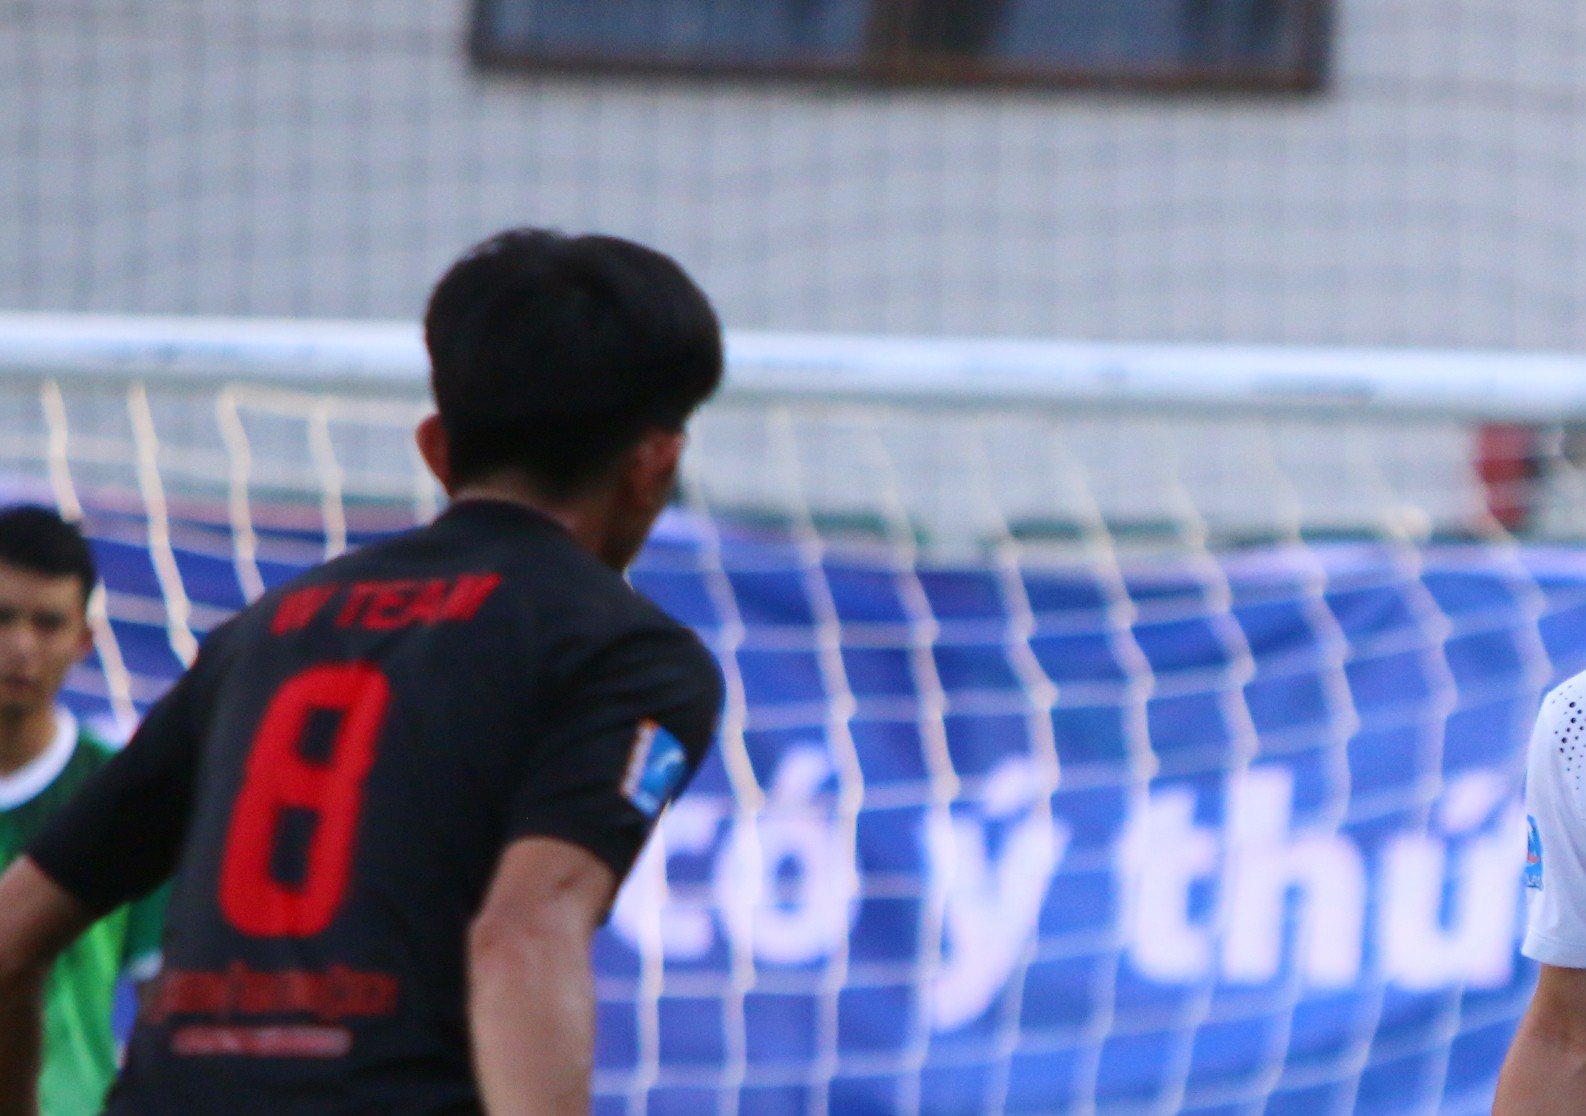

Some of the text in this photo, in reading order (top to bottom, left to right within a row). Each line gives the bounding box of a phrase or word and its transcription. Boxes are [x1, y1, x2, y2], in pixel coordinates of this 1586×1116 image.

[334, 572, 502, 631] TEAM
[219, 659, 390, 937] 8
[607, 742, 1528, 1033] có ý thứ
